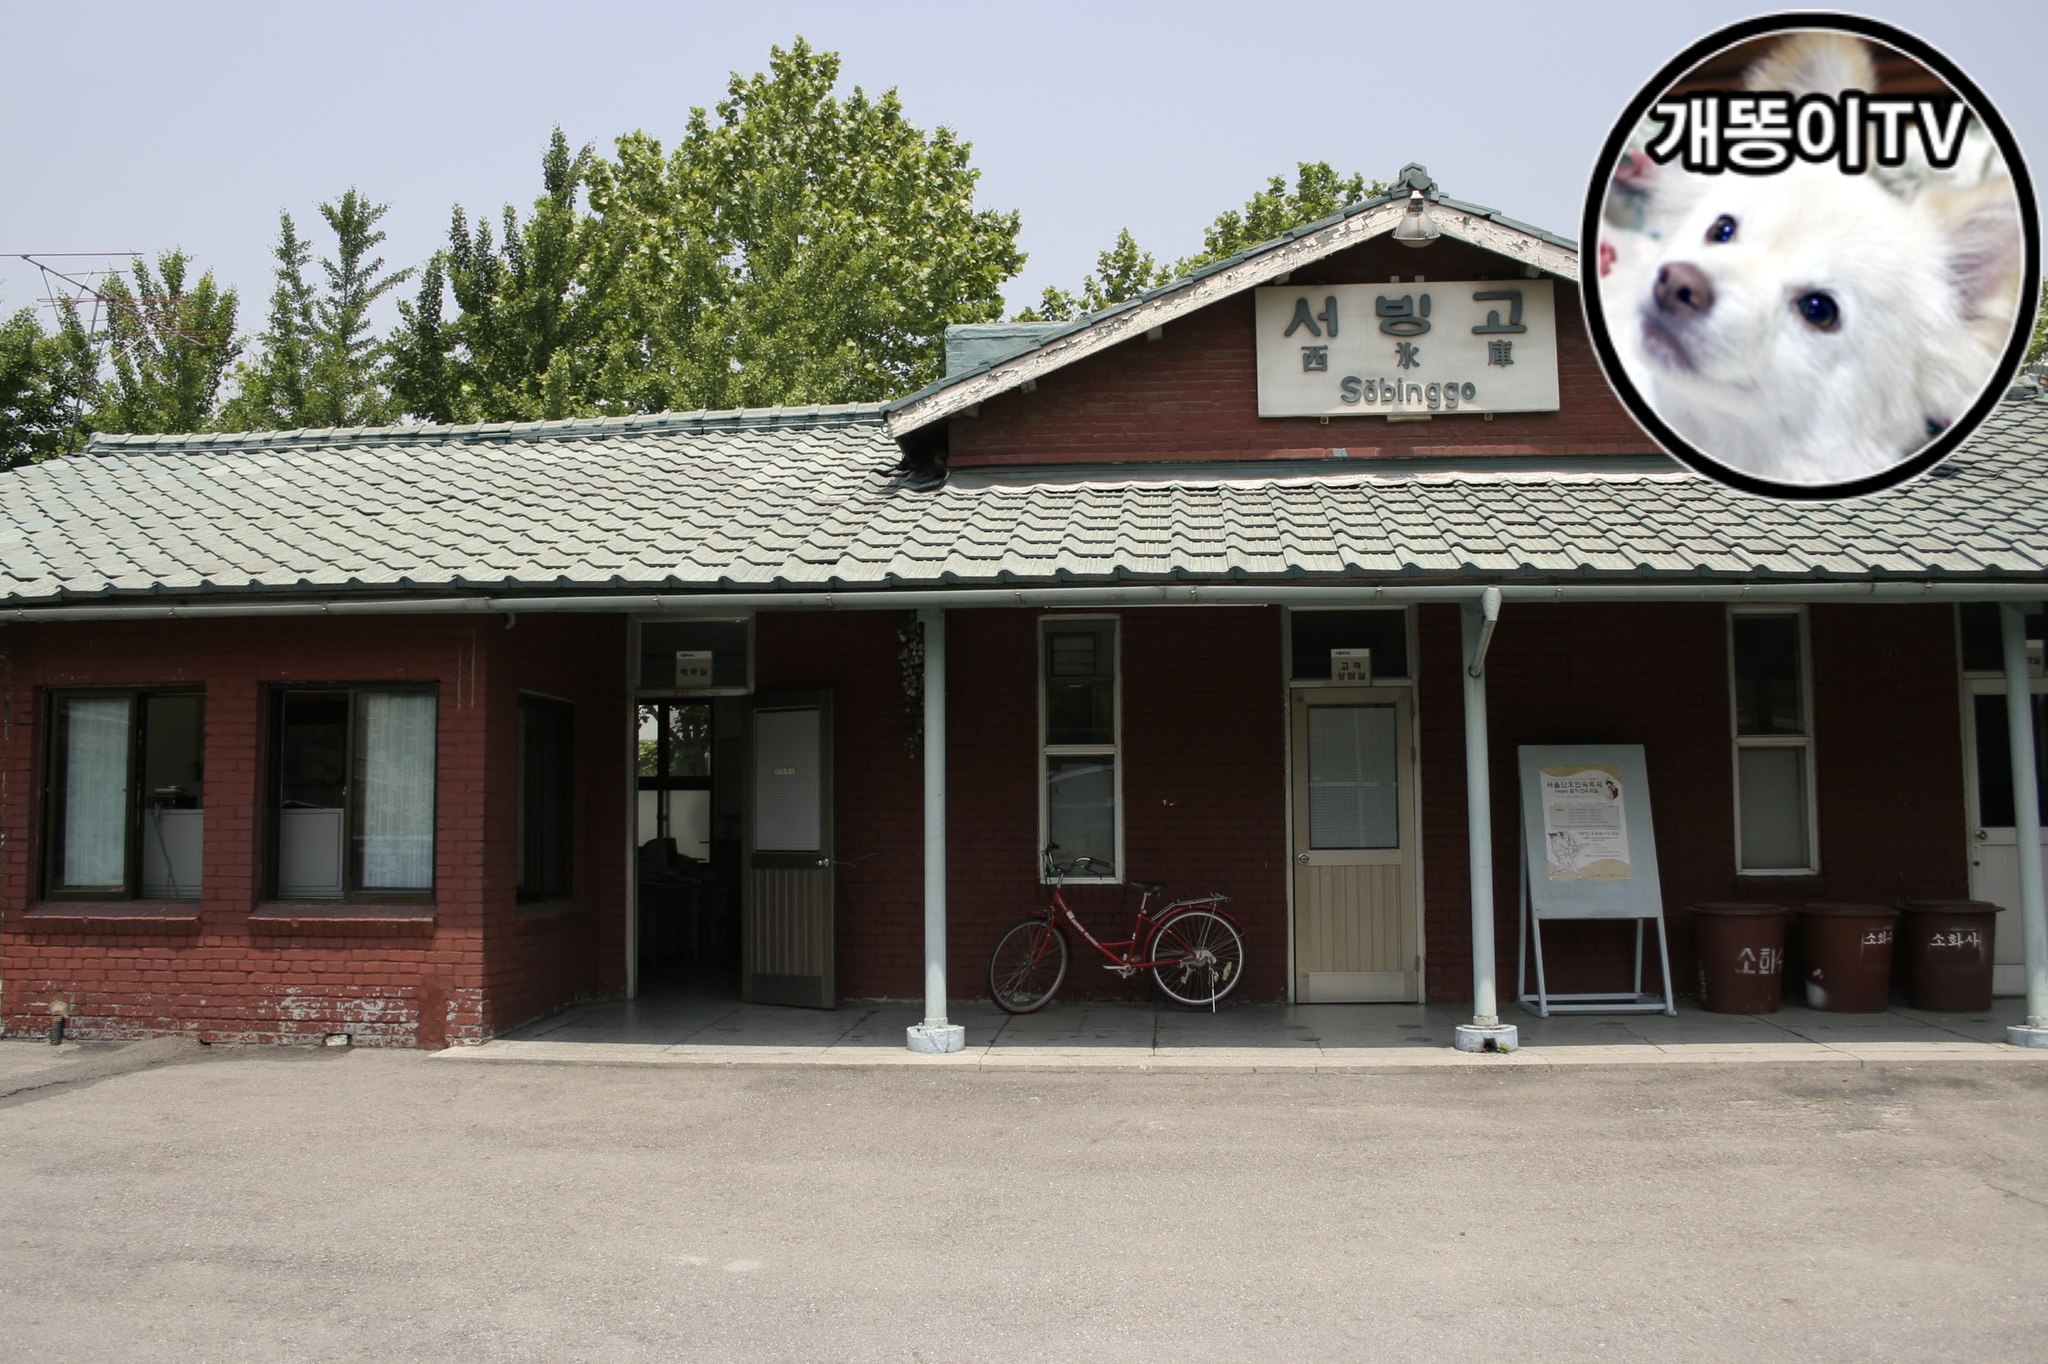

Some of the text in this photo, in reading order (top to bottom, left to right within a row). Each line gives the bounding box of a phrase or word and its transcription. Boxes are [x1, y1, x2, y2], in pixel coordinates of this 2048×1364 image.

[1283, 289, 1528, 337] 서빙고
[1341, 662, 1361, 670] 고객
[1337, 672, 1366, 681] 상담실
[1930, 931, 1981, 948] 소화사
